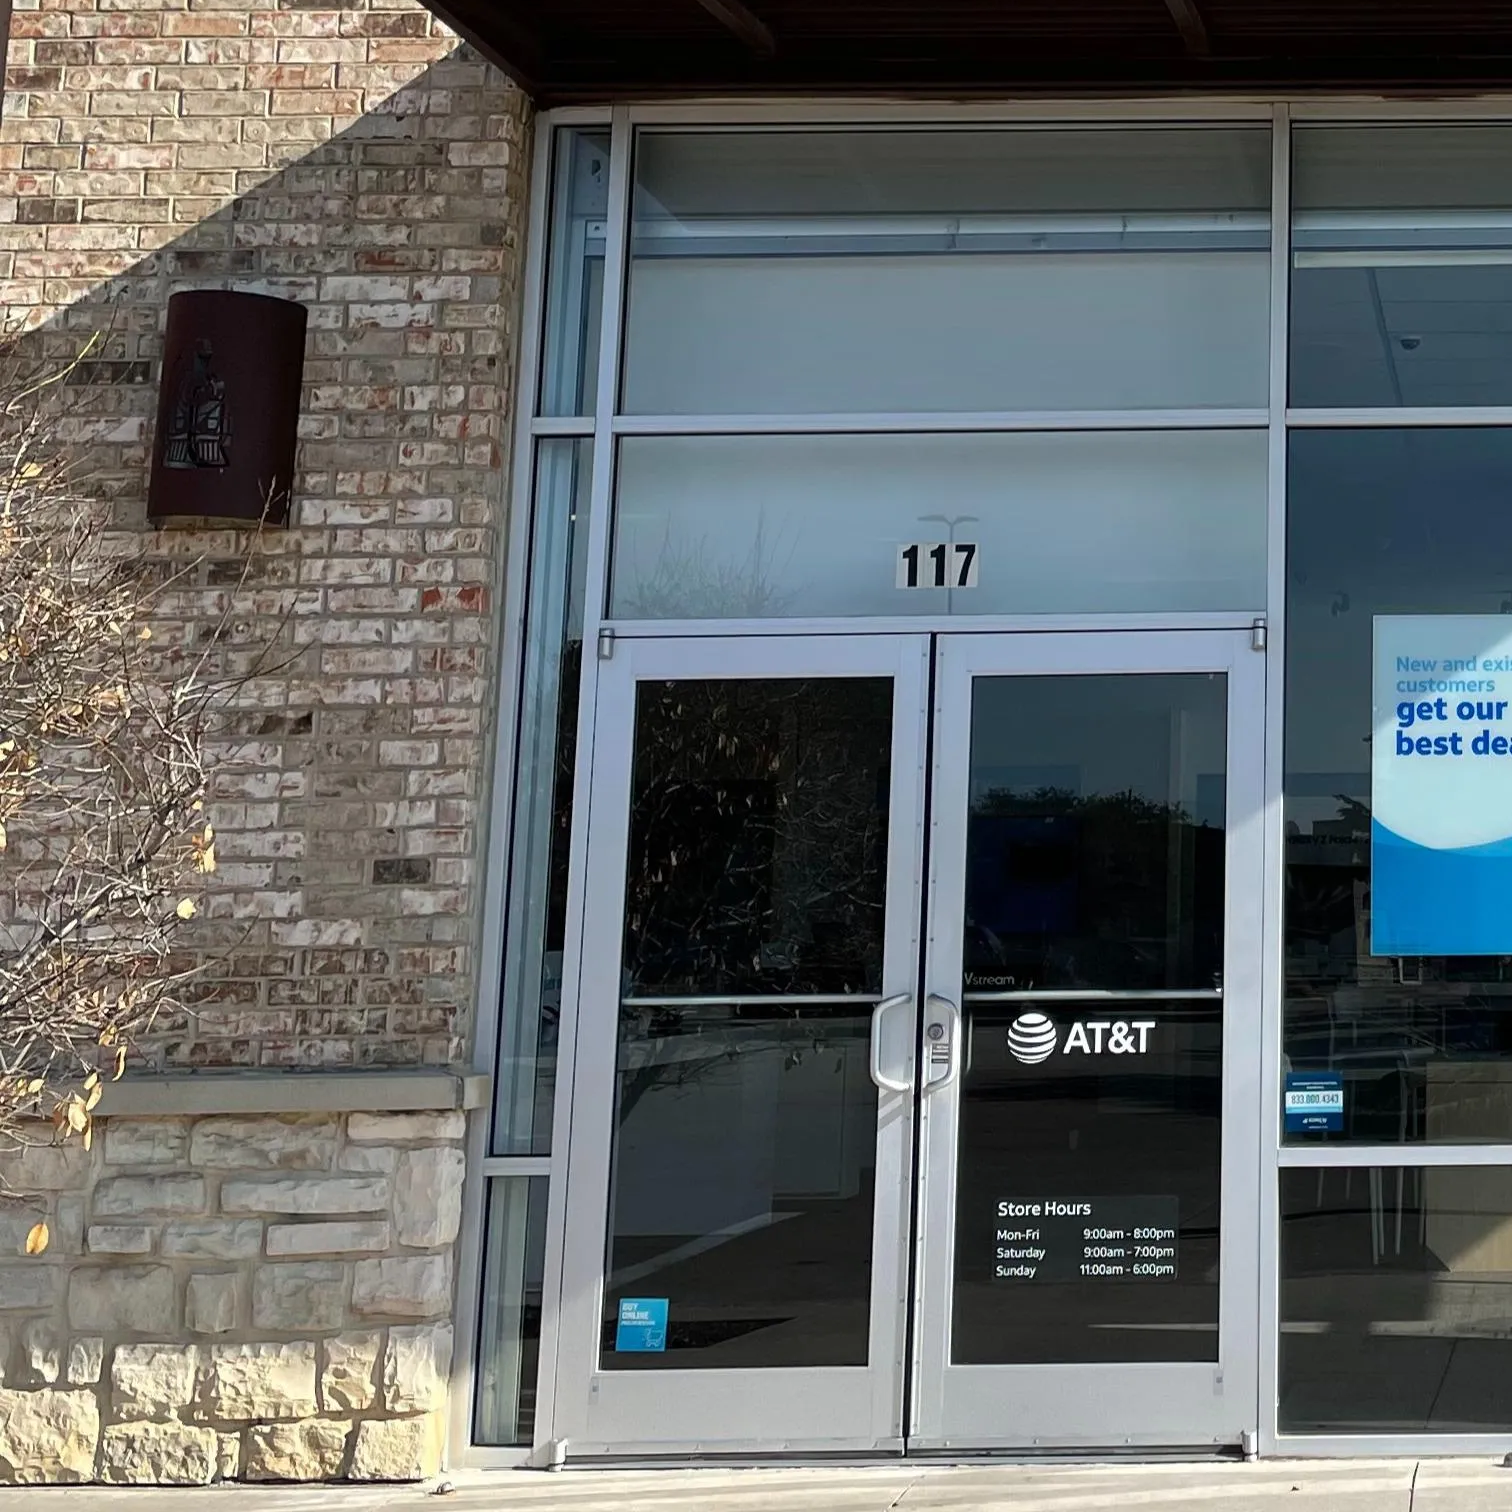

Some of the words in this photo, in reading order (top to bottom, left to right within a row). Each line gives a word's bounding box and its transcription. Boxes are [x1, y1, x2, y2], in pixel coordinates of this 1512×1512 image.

[902, 544, 976, 587] 117
[1396, 656, 1437, 672] New
[1443, 656, 1477, 672] and
[1396, 678, 1496, 693] customers
[1396, 698, 1448, 728] get
[1456, 701, 1508, 720] our
[1396, 730, 1463, 755] best
[1063, 1021, 1156, 1055] AT&T
[998, 1202, 1041, 1217] Store
[1044, 1201, 1092, 1217] Hours
[996, 1229, 1040, 1241] Mon-Fri
[1083, 1228, 1124, 1239] 9:00am
[1133, 1228, 1175, 1241] 8:00pm
[996, 1247, 1046, 1261] Saturday
[1083, 1246, 1125, 1258] 9:00am
[1134, 1246, 1175, 1259] 7:00pm
[996, 1265, 1037, 1279] Sunday
[1080, 1264, 1123, 1275] 11:00am
[1133, 1264, 1174, 1277] 6:00pm
